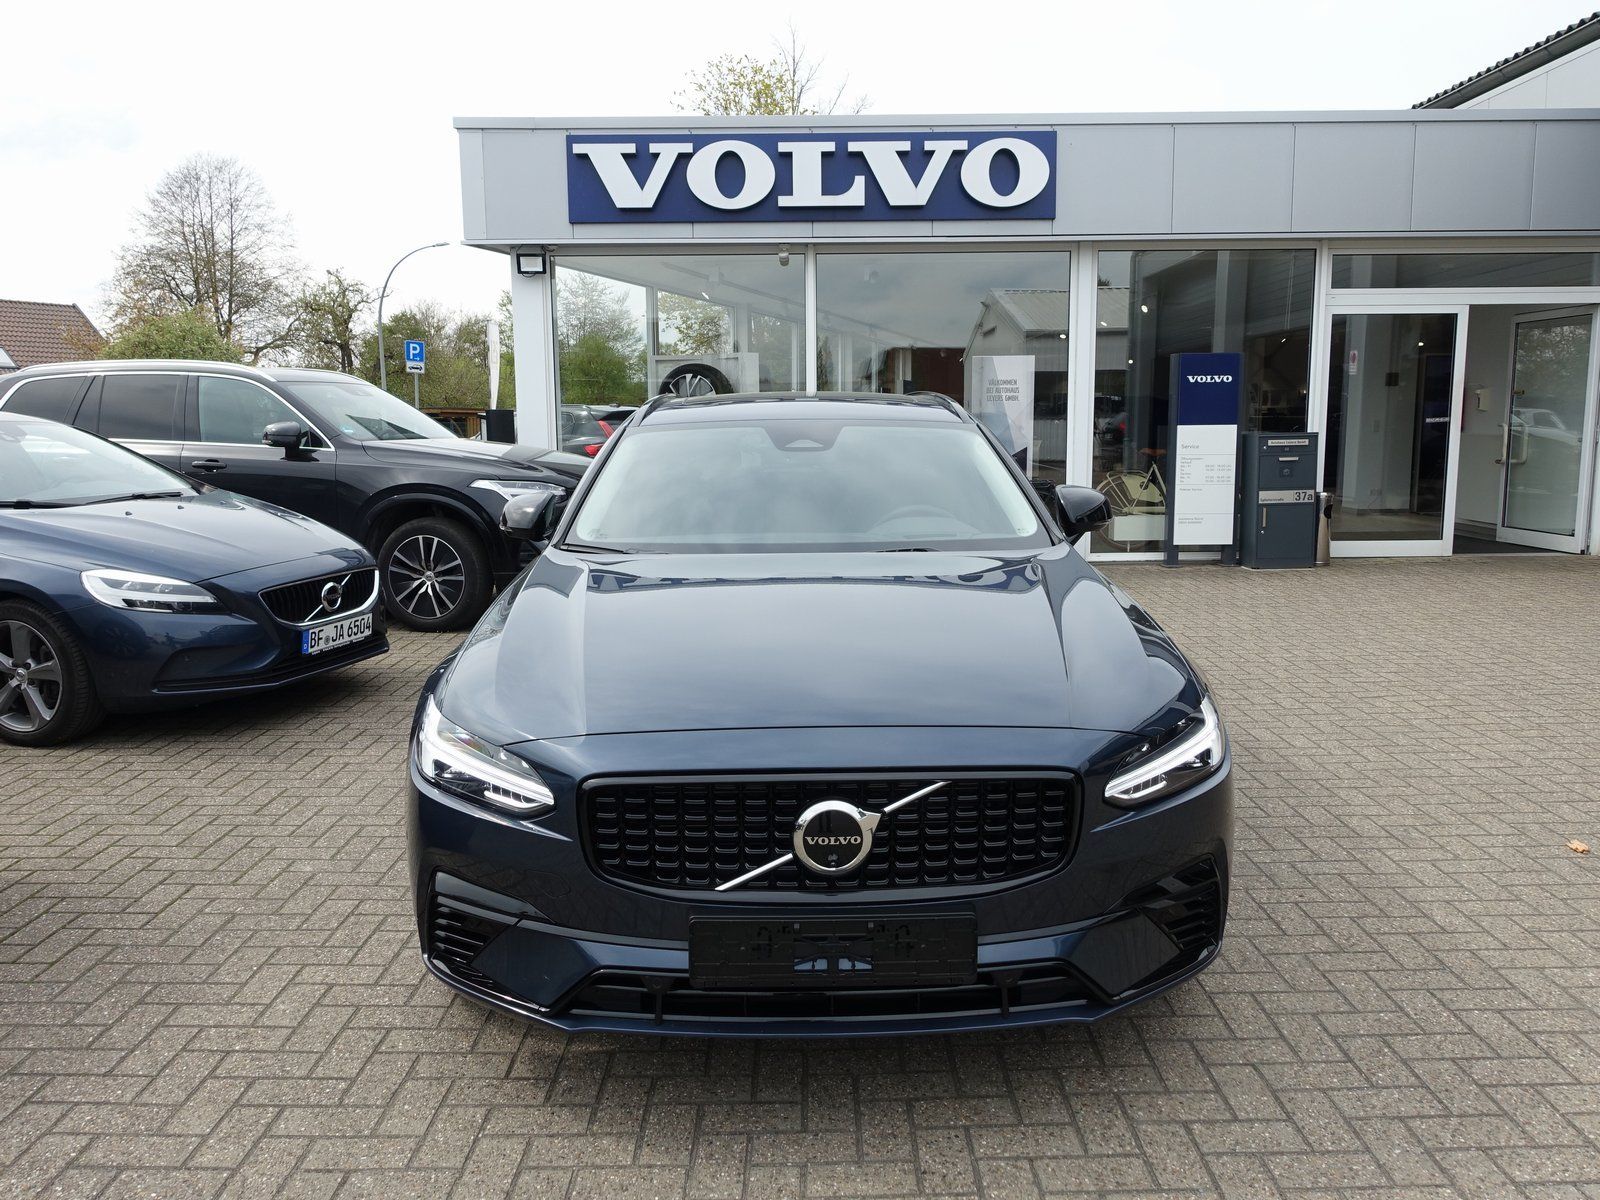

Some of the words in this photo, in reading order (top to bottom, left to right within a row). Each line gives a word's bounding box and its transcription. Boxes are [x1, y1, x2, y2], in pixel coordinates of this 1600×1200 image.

[572, 137, 1050, 209] VOLVO
[409, 343, 420, 359] P
[1186, 375, 1233, 383] VOLVO
[1295, 491, 1313, 502] 37a
[310, 629, 323, 649] BF
[331, 624, 344, 642] JA
[347, 616, 371, 637] 6504
[804, 835, 862, 845] VOLVO
